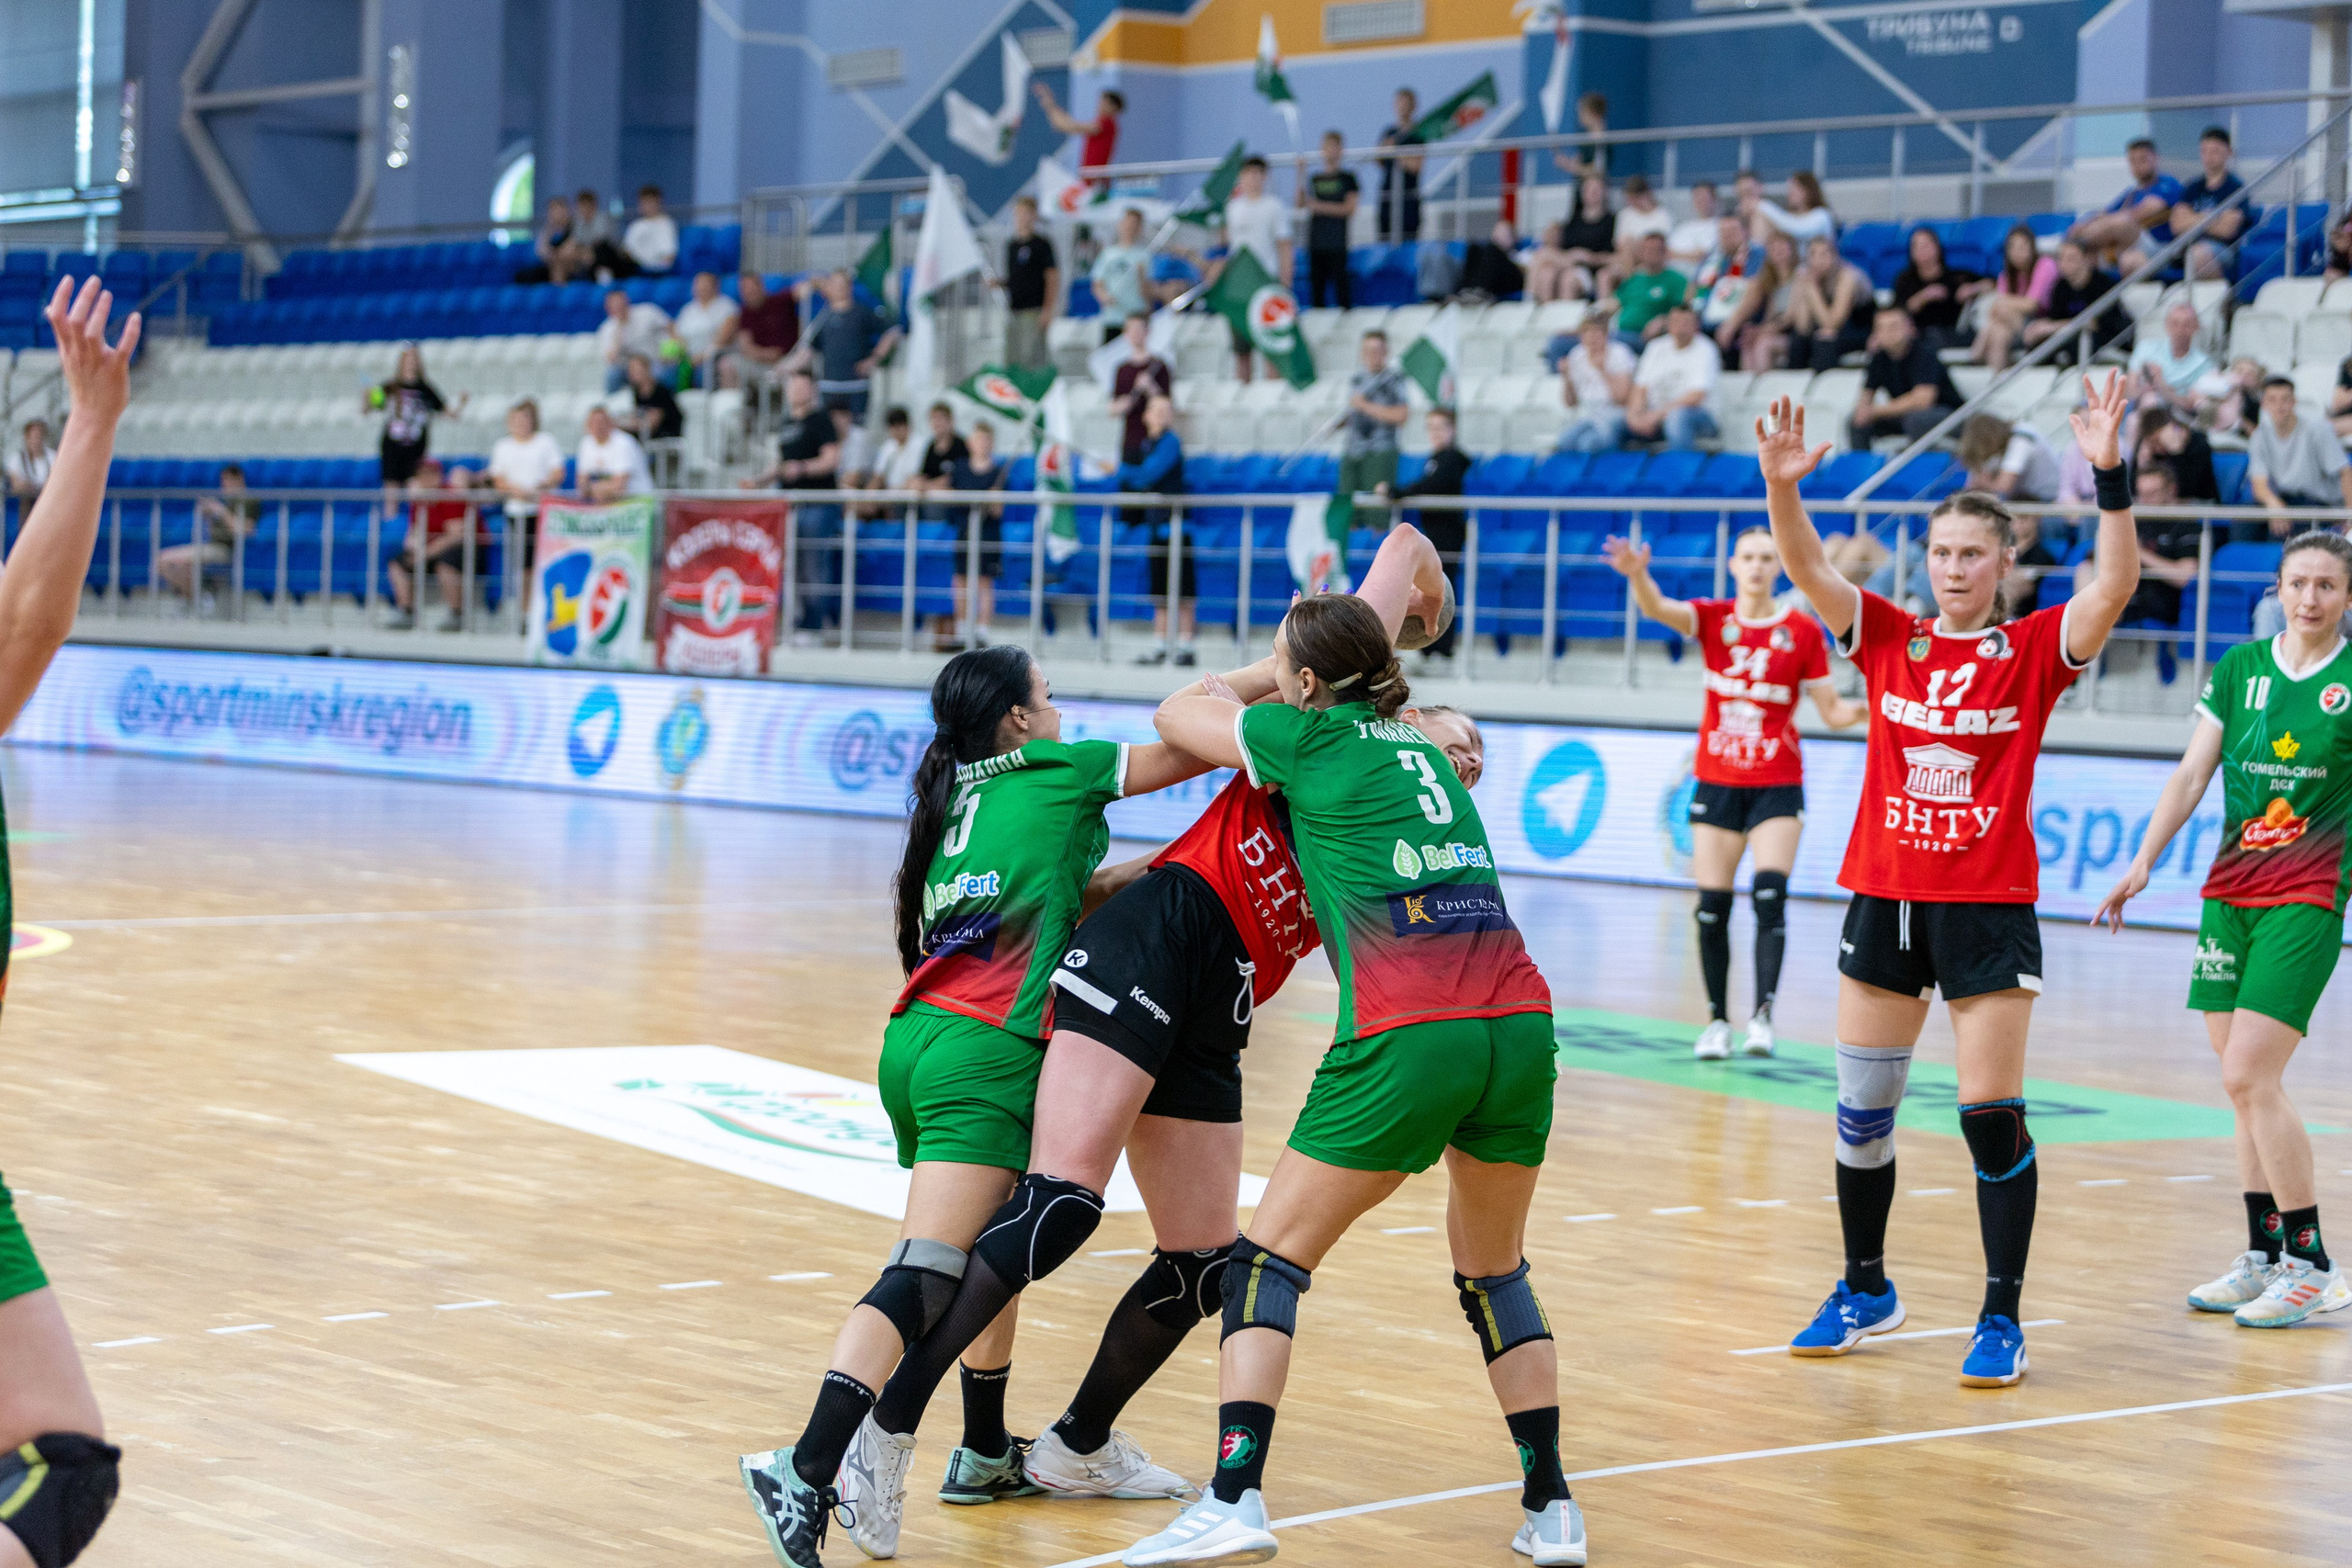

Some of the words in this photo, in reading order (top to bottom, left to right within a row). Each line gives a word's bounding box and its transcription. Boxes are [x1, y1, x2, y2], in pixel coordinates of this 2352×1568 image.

[117, 666, 472, 756] @sportminskregion
[1882, 691, 2020, 735] BELAZ
[2245, 675, 2272, 711] 10
[1396, 750, 1453, 825] 3
[2242, 761, 2328, 779] ГОМЕЛЬСКИЙ
[944, 777, 992, 858] 5
[1884, 796, 1999, 839] БНТУ
[1421, 843, 1492, 871] BelFert
[935, 871, 1000, 910] BelFert
[1129, 986, 1171, 1025] Kempa
